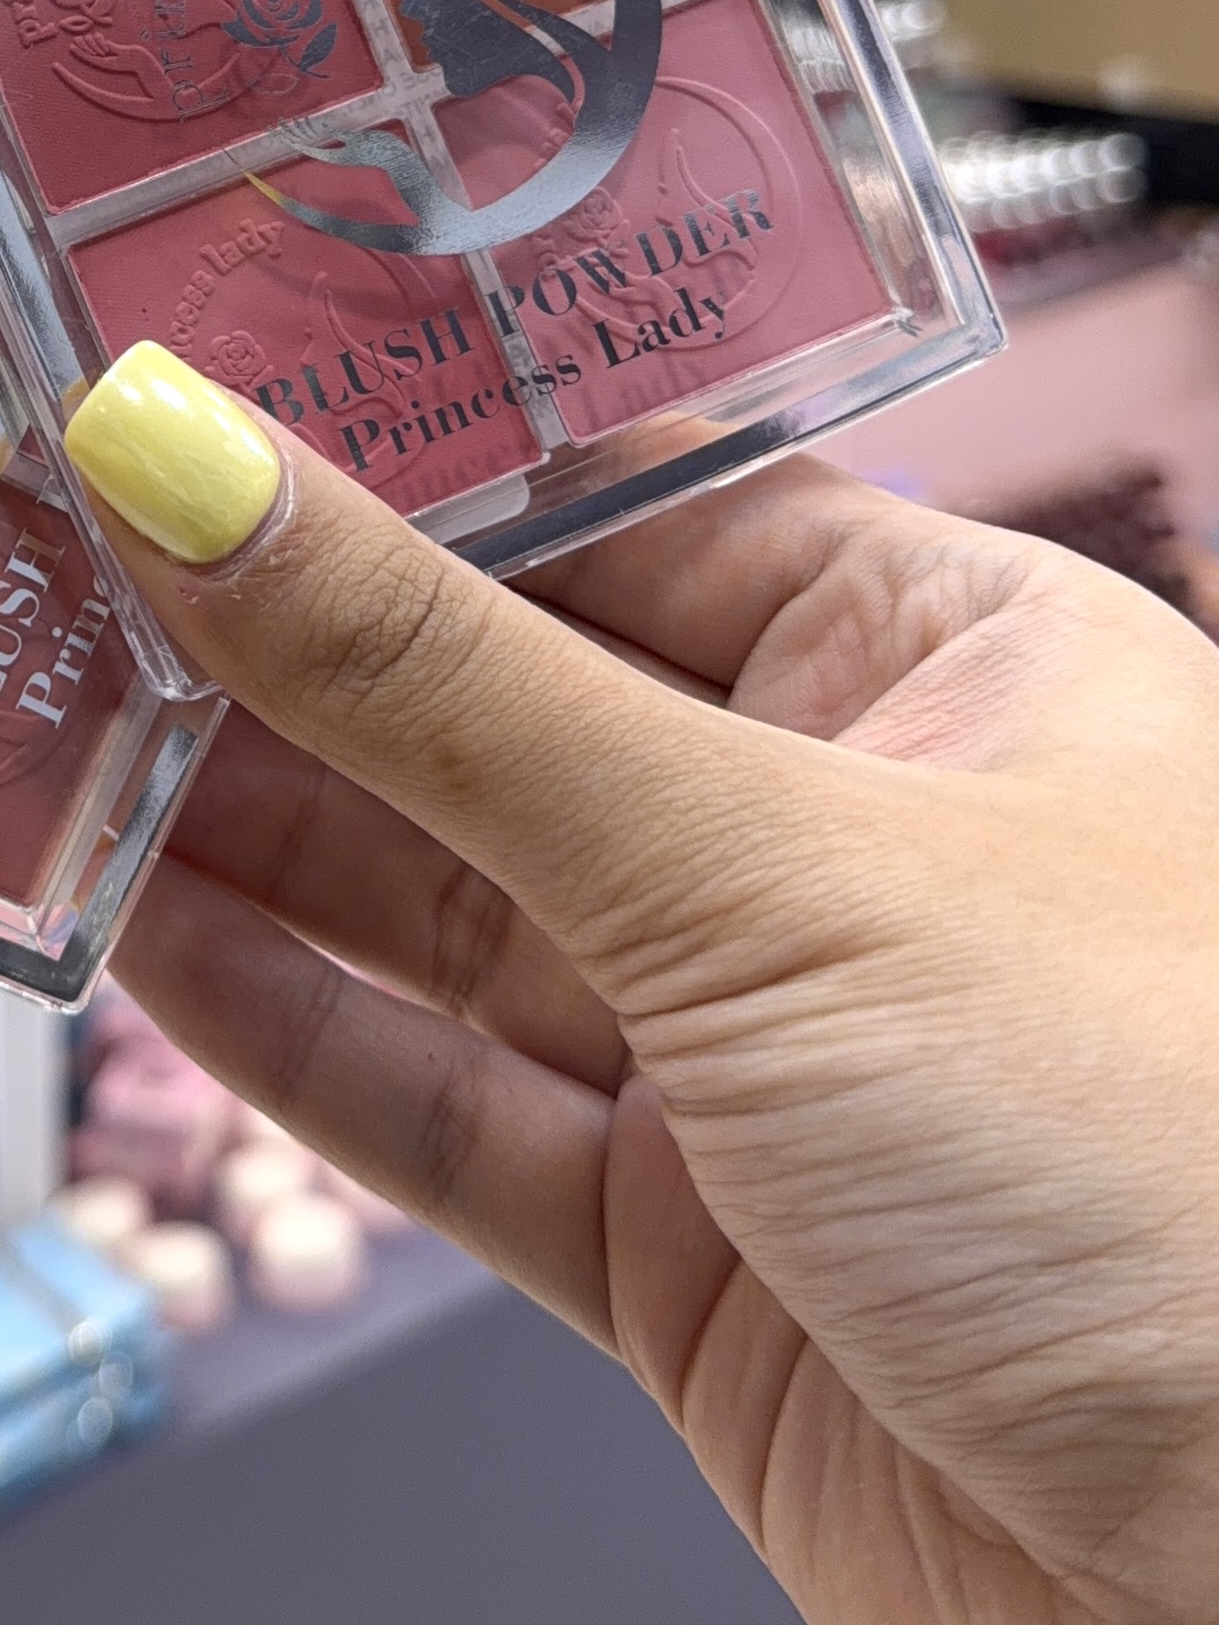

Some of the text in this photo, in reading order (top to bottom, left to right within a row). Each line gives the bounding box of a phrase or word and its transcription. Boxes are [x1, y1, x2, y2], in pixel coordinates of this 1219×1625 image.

[199, 218, 285, 276] lady
[255, 189, 773, 428] BLUSH POWDER
[339, 286, 726, 472] Princess Lady
